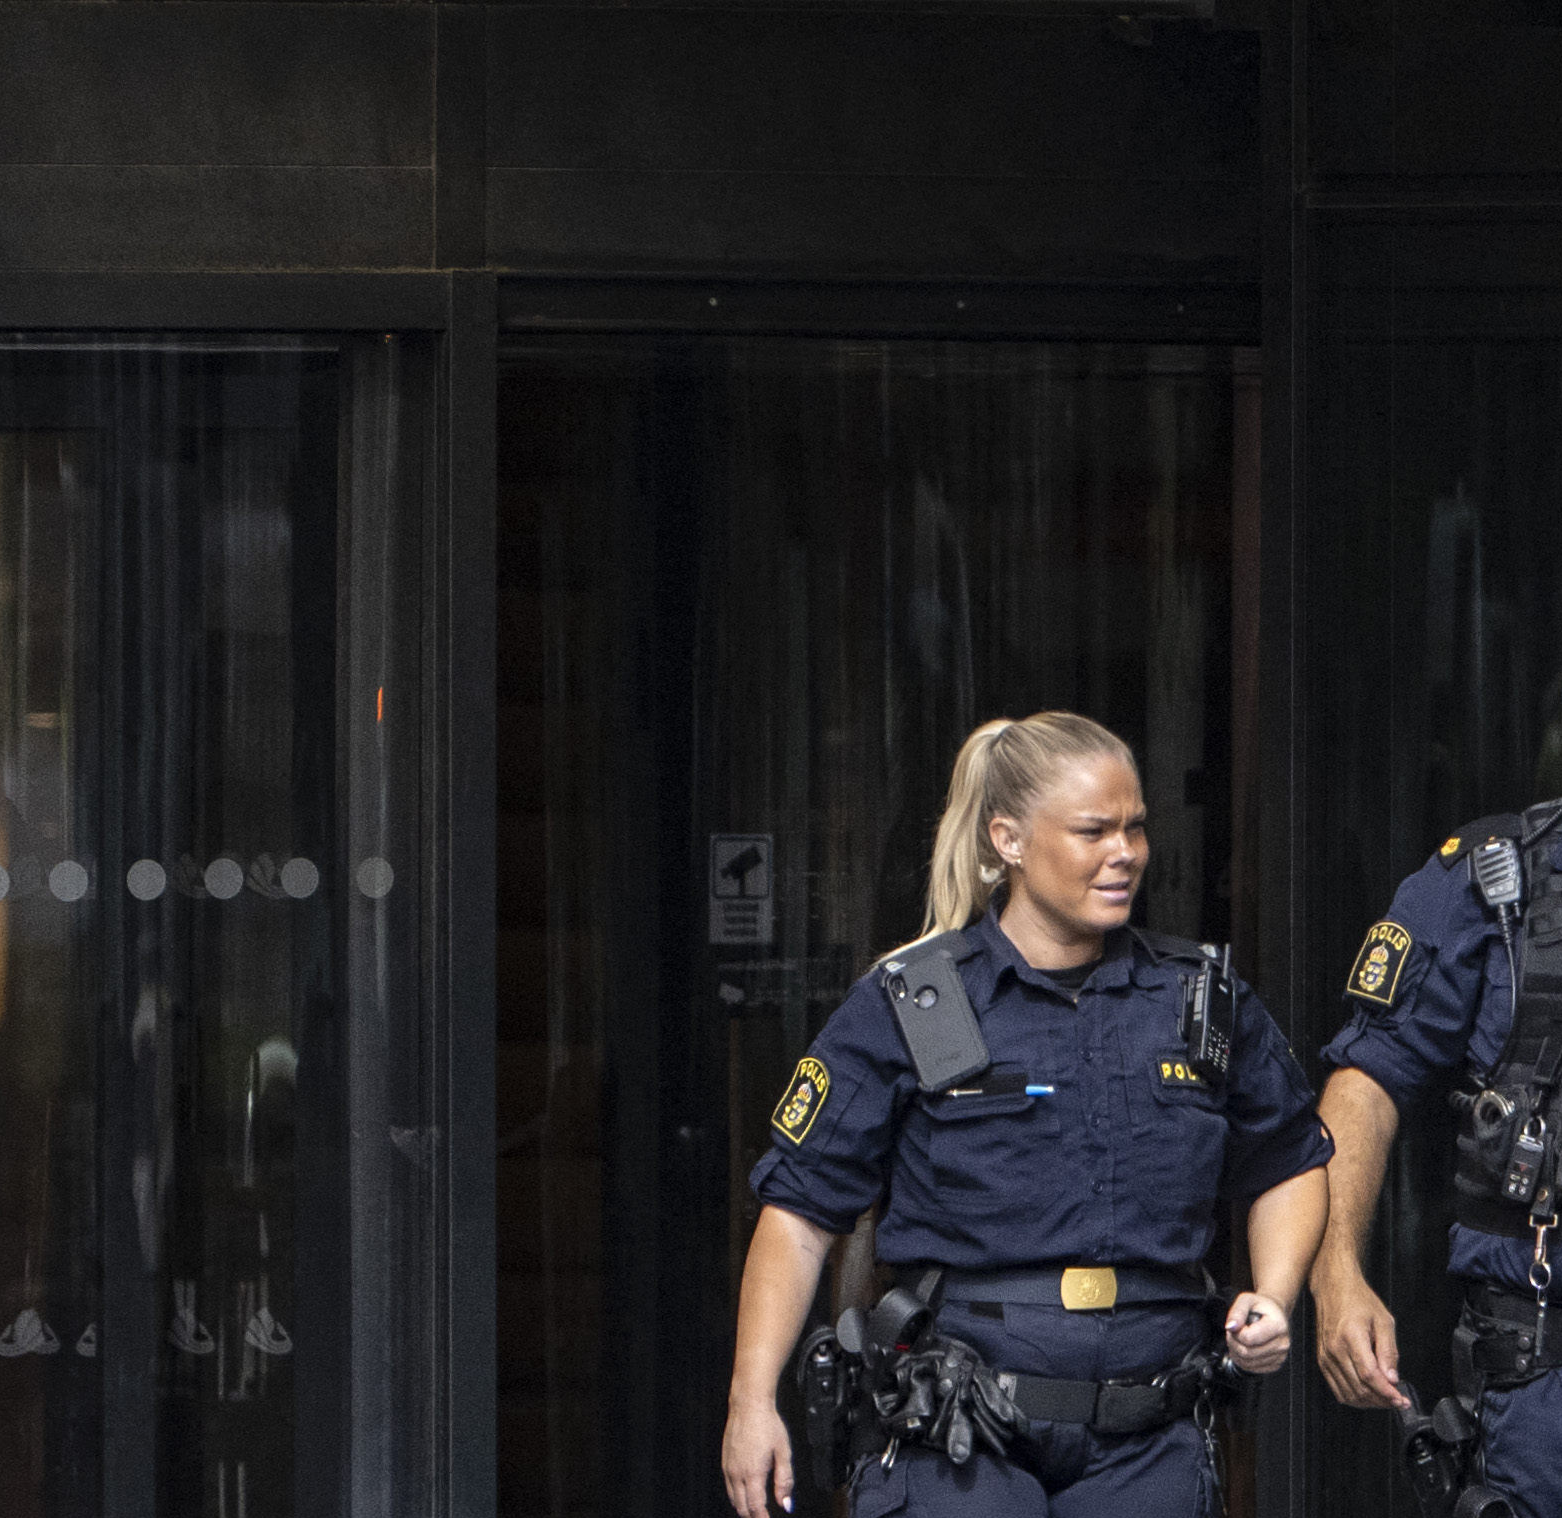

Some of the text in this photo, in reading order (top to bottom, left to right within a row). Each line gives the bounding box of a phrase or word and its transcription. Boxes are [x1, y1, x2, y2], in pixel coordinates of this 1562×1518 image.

[1369, 925, 1407, 951] POLIS
[799, 1061, 826, 1094] POLIS
[1161, 1061, 1197, 1081] POL
